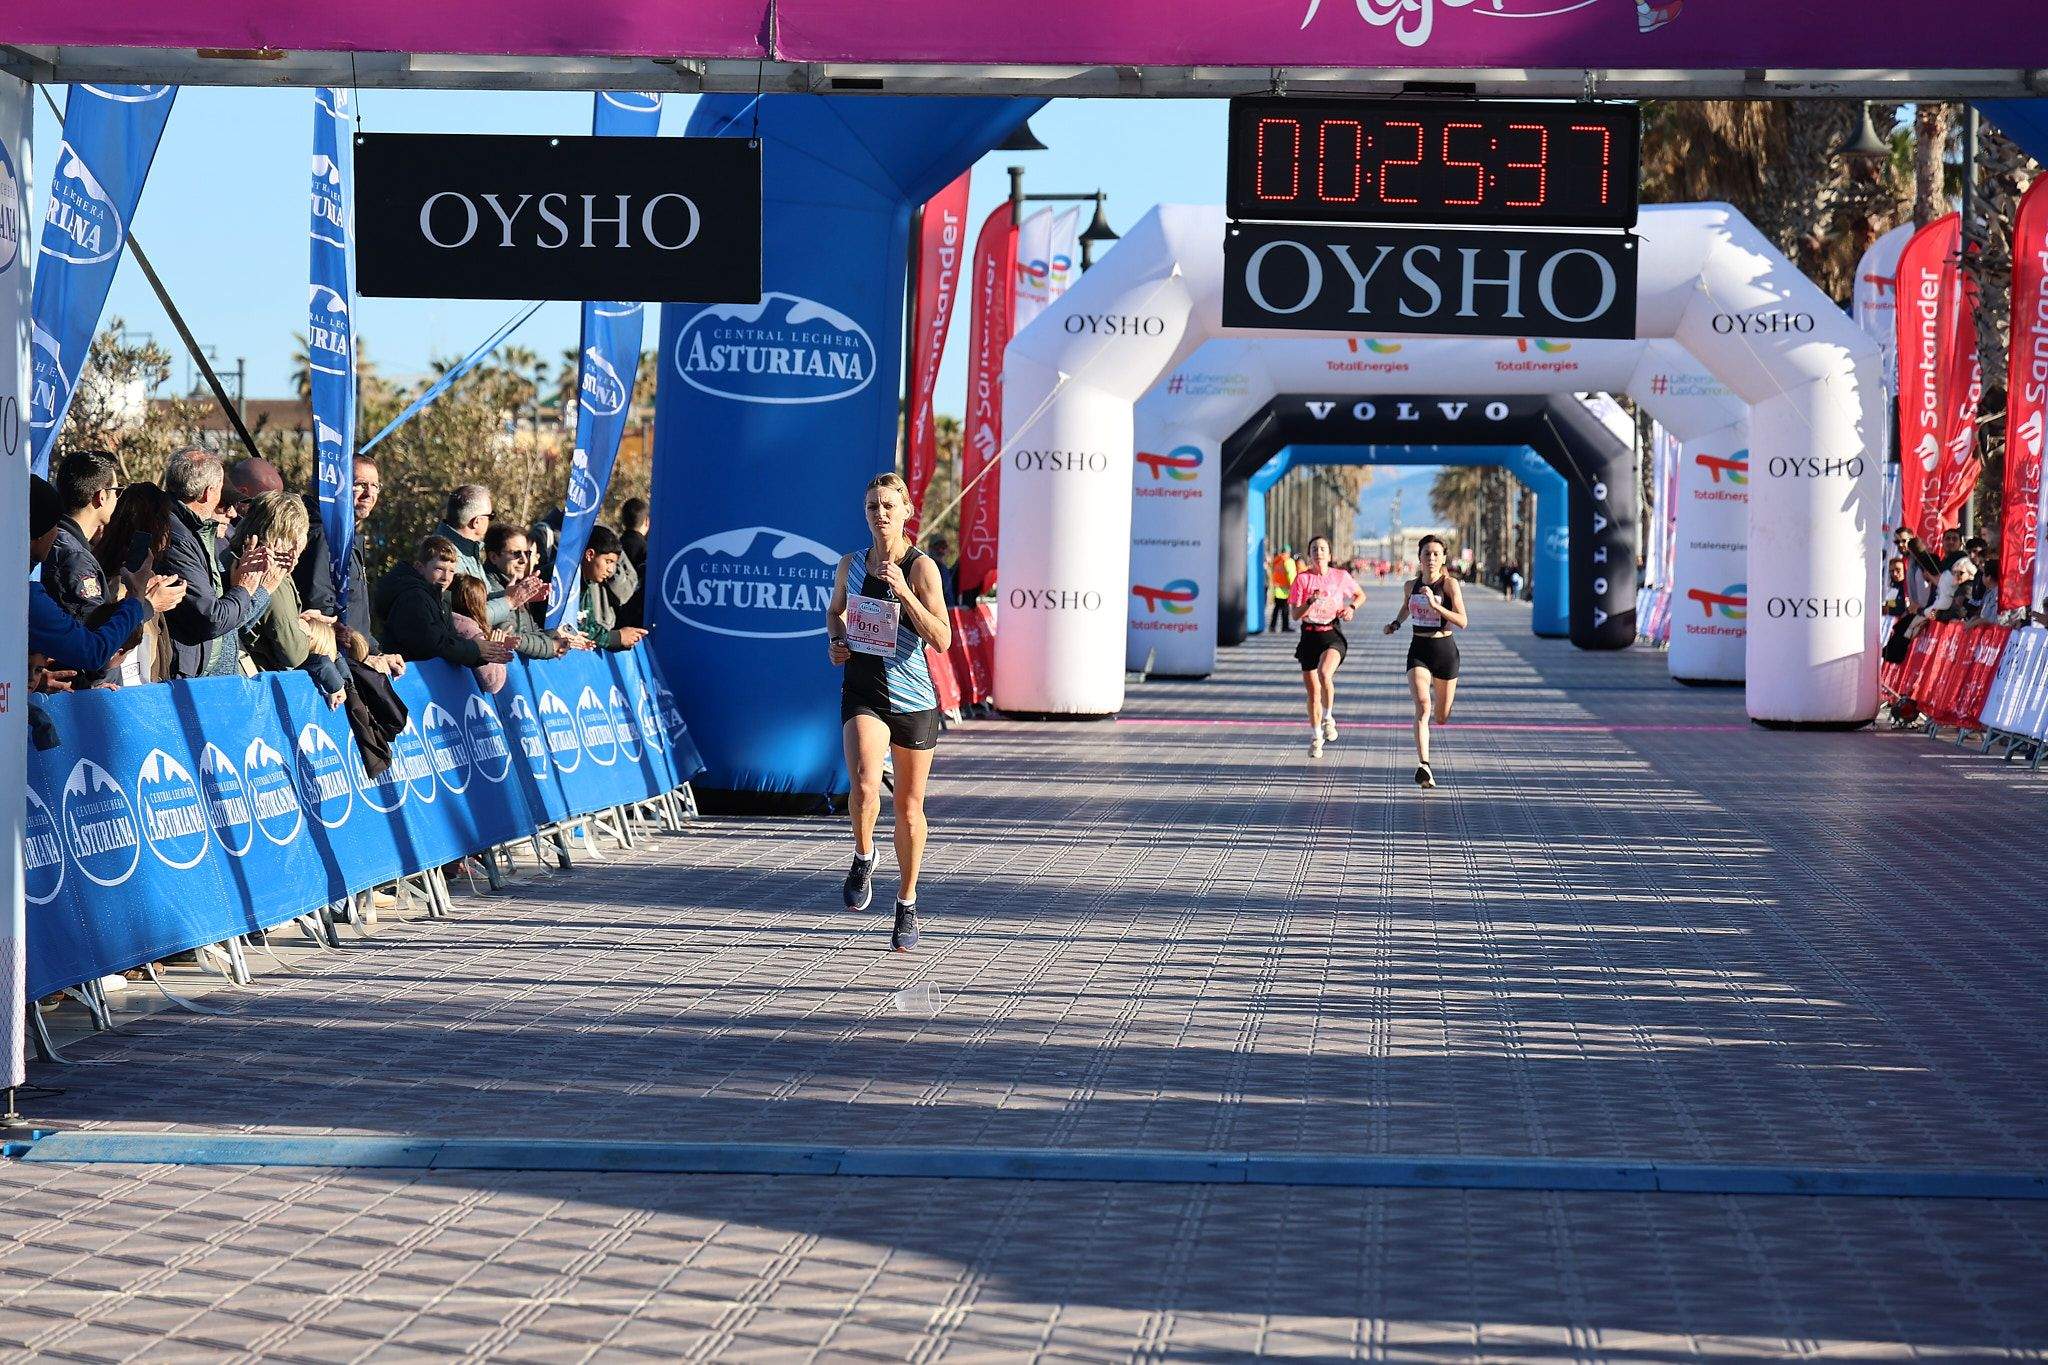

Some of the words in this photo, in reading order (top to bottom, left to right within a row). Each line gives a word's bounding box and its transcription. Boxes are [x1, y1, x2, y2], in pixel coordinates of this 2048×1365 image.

[419, 191, 703, 251] OYSHO
[1244, 239, 1617, 323] OYSHO
[1064, 313, 1165, 337] OYSHO
[1712, 311, 1815, 335] OYSHO
[713, 328, 784, 341] CENTRAL
[791, 332, 859, 348] LECHERA
[1916, 266, 1940, 430] Santander
[684, 330, 863, 381] ASTURIANA
[1326, 360, 1409, 374] TotalEnergies
[1494, 360, 1579, 374] TotalEnergies
[1305, 401, 1510, 422] VOLVO
[1015, 450, 1107, 473] OYSHO
[1768, 456, 1864, 479] OYSHO
[1135, 487, 1203, 499] TotalEnergies
[1593, 481, 1609, 629] VOLVO
[700, 562, 772, 576] CENTRAL
[1010, 588, 1101, 611] OYSHO
[1767, 597, 1863, 619] OYSHO
[858, 621, 880, 634] 016
[1130, 620, 1199, 633] TotalEnergies
[144, 795, 206, 842] ASTURIANA
[69, 810, 137, 859] ASTURIANA
